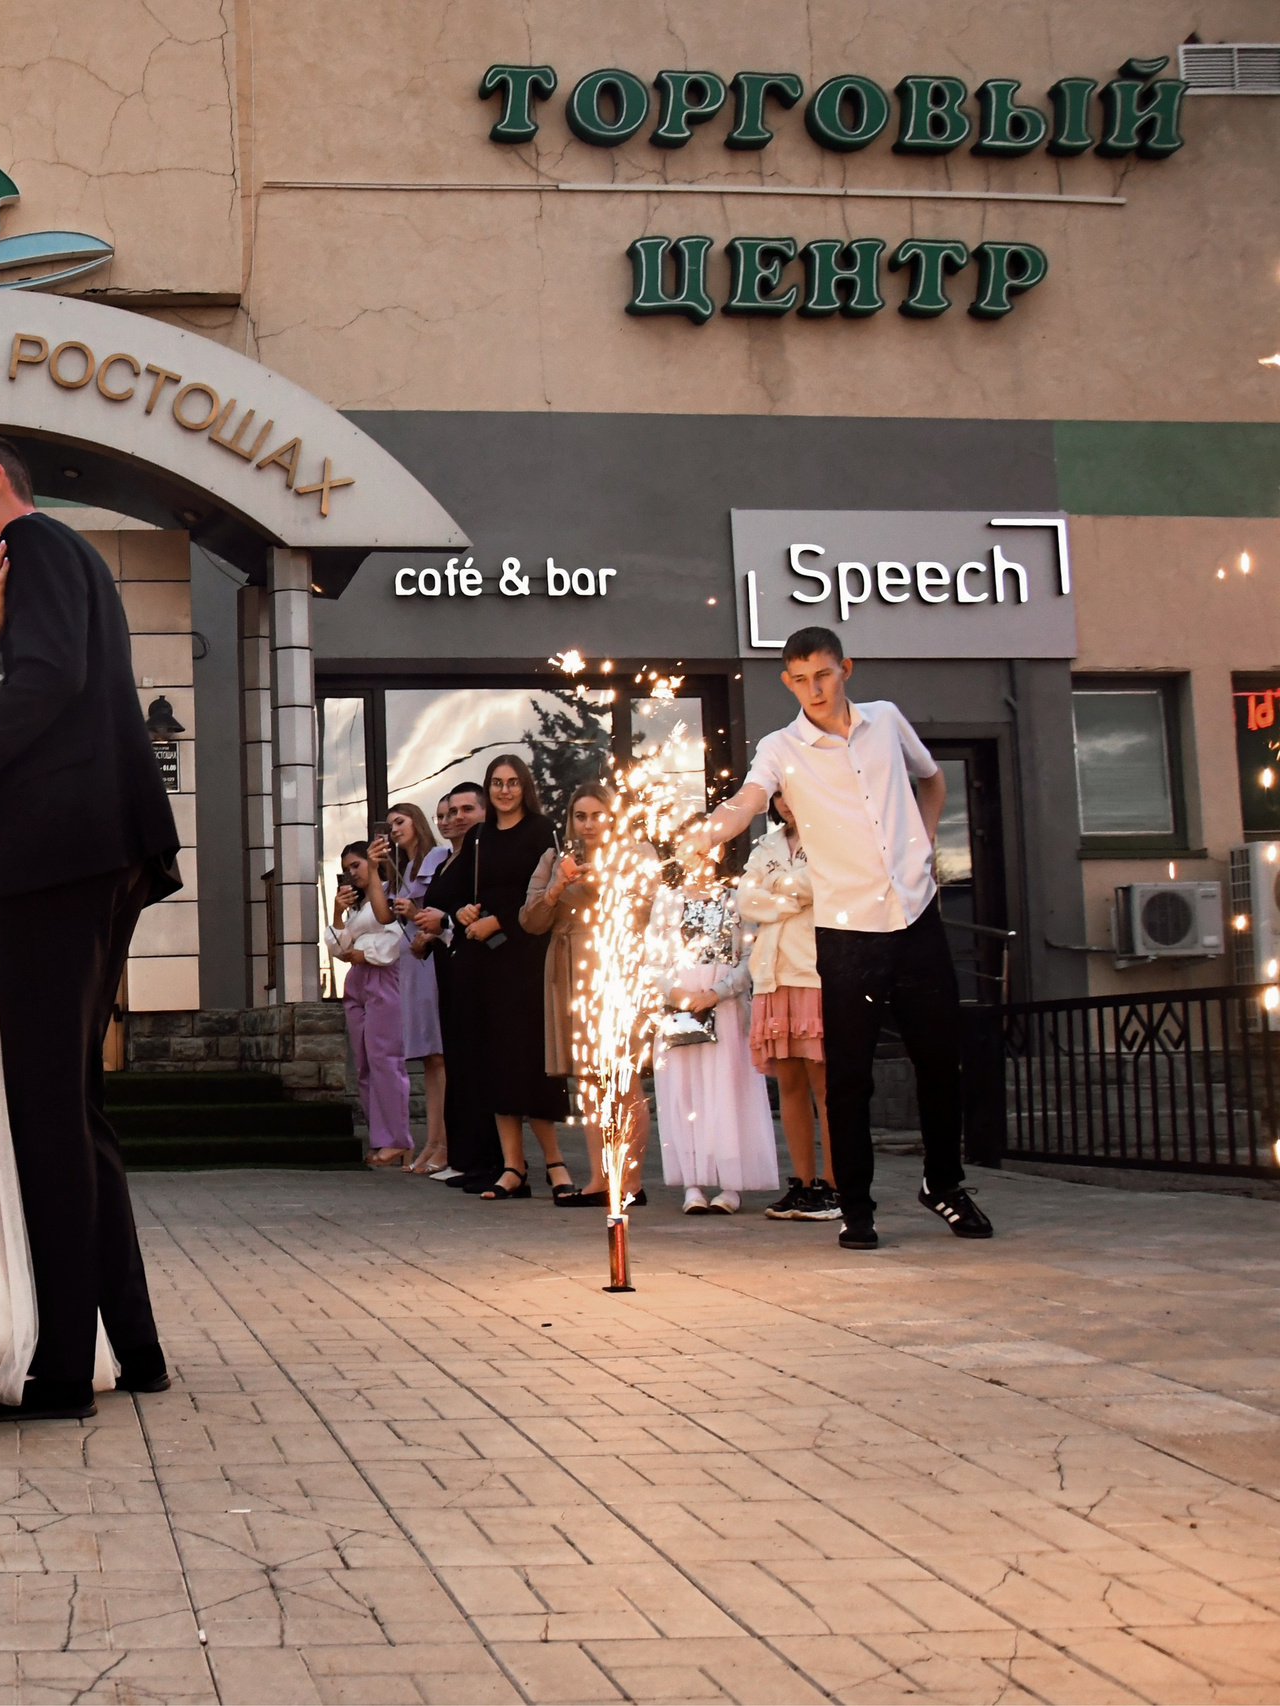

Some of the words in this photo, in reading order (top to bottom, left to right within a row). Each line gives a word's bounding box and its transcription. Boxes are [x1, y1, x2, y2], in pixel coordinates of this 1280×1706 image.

[478, 55, 1189, 160] ТОРГОВЫЙ
[625, 236, 1048, 325] ЦЕНТР
[7, 331, 356, 517] РОСТОШАХ
[394, 557, 484, 597] café
[498, 556, 532, 597] &
[545, 557, 618, 597] bar
[789, 543, 1029, 621] Speech
